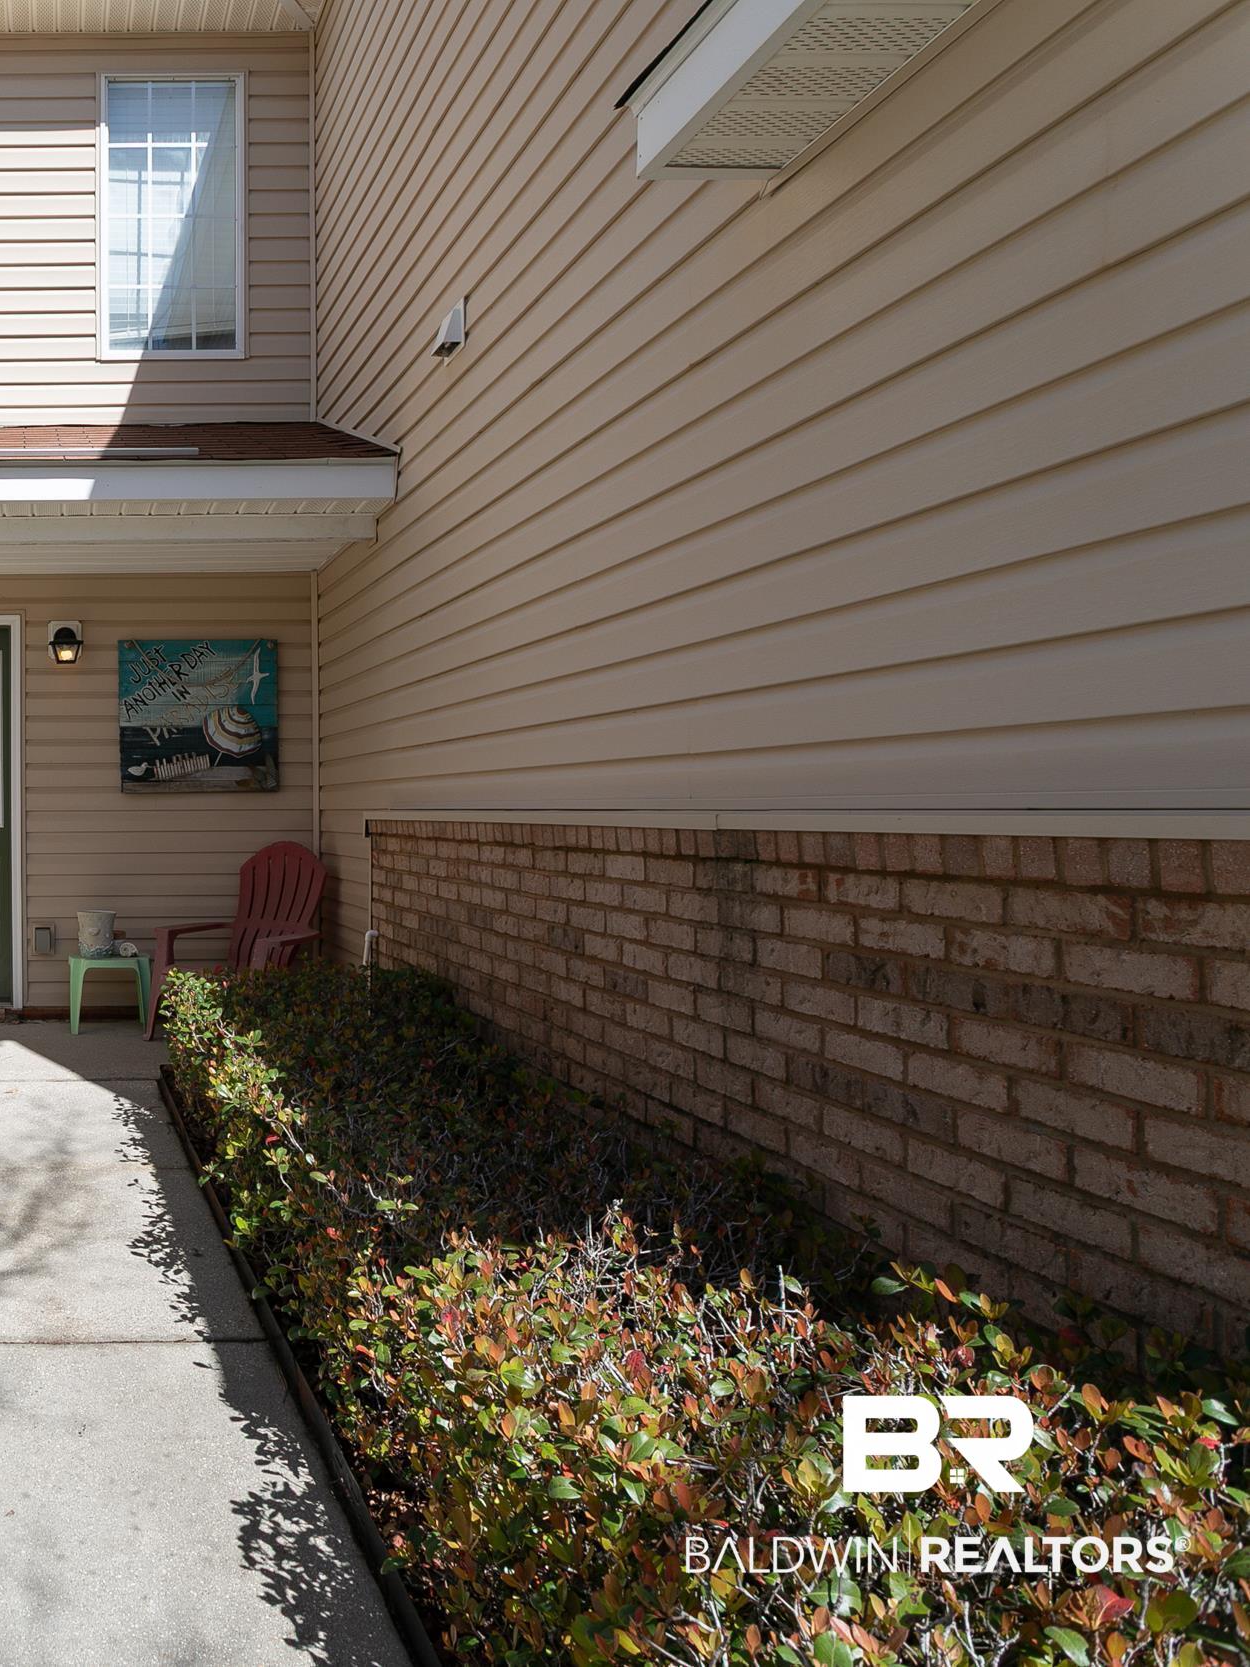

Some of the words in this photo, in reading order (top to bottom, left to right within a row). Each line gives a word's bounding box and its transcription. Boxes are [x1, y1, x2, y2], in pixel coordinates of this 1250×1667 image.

[122, 662, 189, 720] ANOTHER
[180, 641, 216, 670] DAY
[127, 645, 167, 684] JUST
[171, 684, 191, 702] IN
